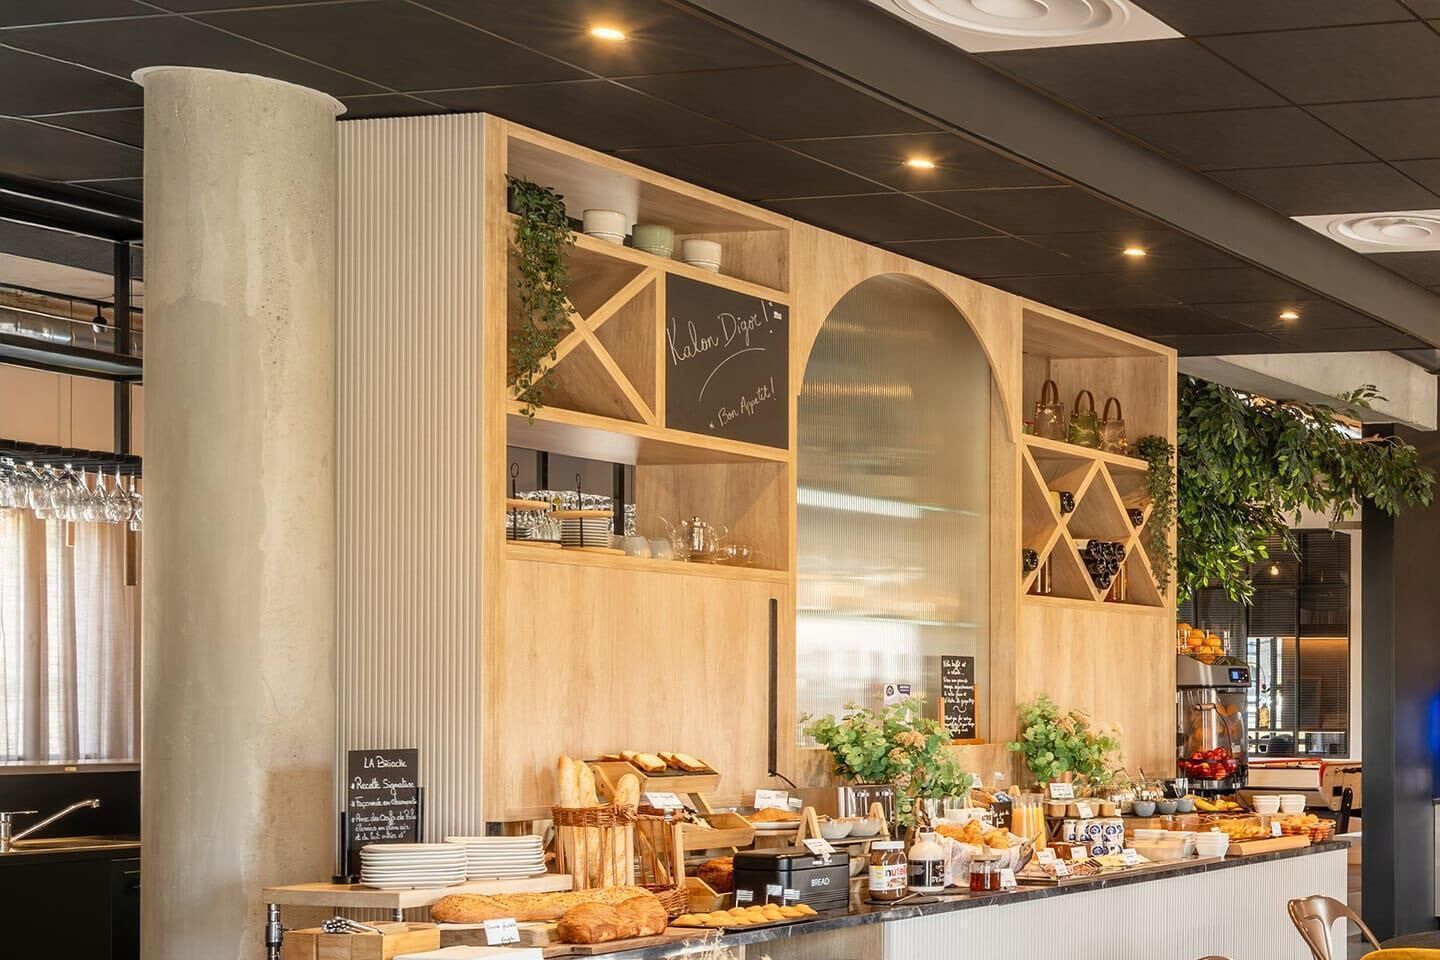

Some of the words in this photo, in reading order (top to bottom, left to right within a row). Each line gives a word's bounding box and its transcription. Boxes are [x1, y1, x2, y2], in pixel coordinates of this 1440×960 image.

[666, 317, 719, 366] Kalon
[718, 407, 739, 427] Bon
[364, 757, 375, 769] LA
[354, 776, 381, 789] Recette
[382, 777, 415, 795] Signature
[811, 877, 830, 887] BREAD
